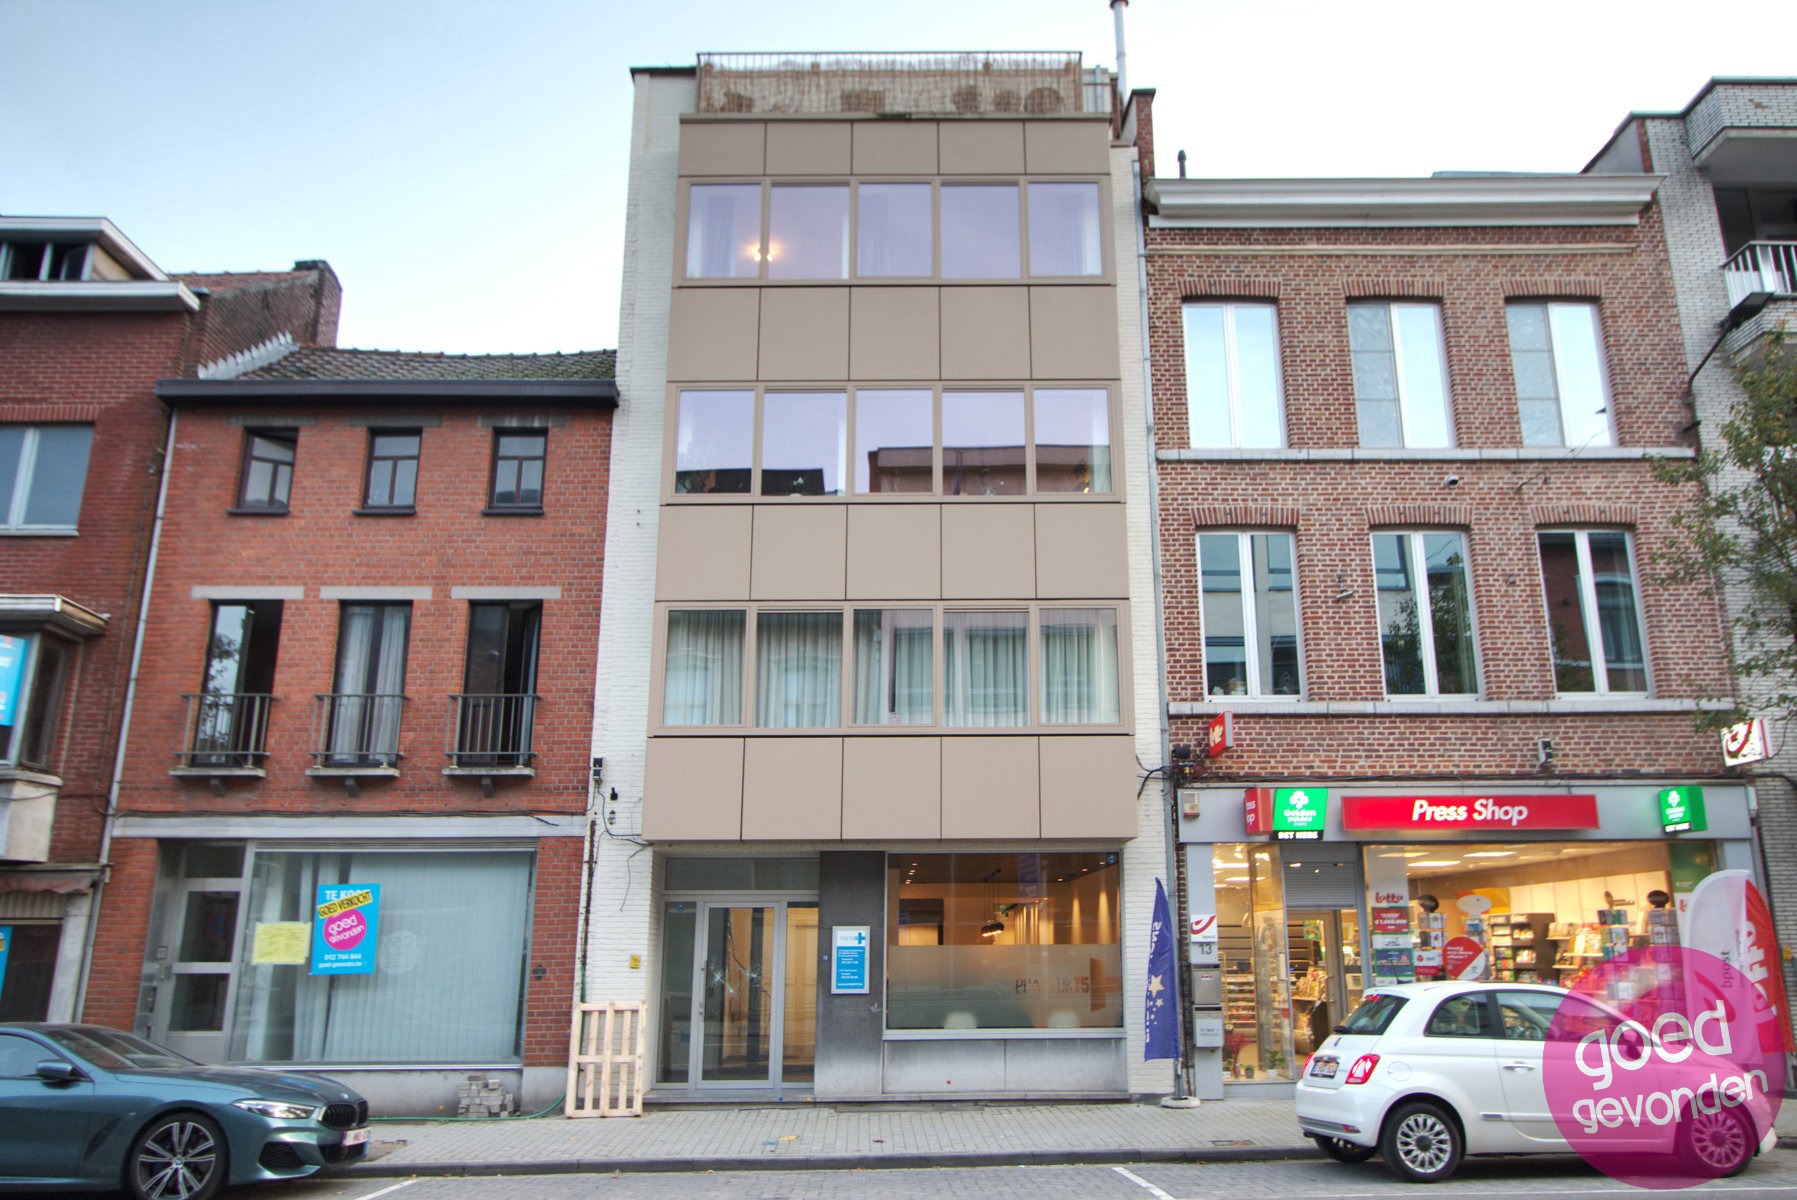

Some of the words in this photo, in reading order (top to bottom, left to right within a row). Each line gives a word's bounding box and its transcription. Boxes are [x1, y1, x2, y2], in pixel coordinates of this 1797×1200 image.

[1411, 799, 1468, 821] Press
[1472, 798, 1529, 826] Shop
[325, 890, 337, 900] TE
[328, 915, 358, 935] goed
[1199, 943, 1213, 955] 13
[1721, 951, 1735, 988] bpost
